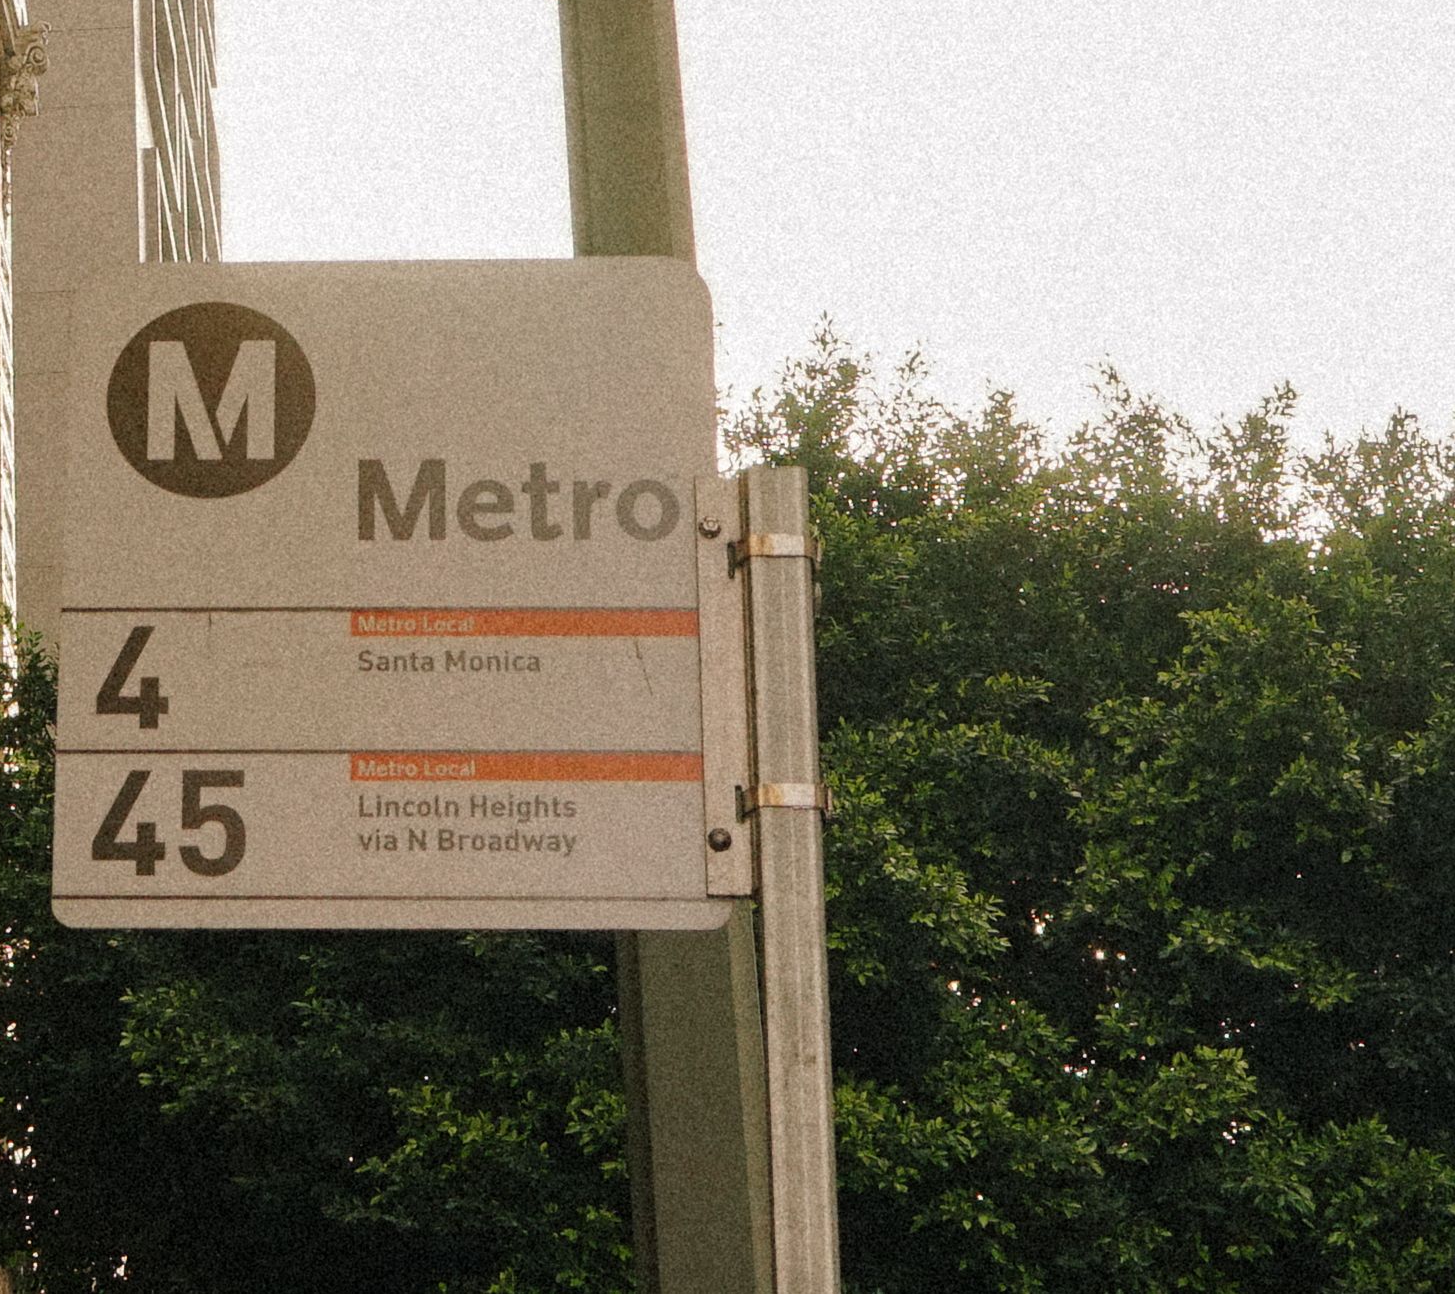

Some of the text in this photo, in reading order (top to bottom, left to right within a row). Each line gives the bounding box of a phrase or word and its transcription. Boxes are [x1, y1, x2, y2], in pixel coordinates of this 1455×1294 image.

[146, 339, 277, 461] M
[357, 458, 680, 541] Metro
[357, 615, 476, 632] Metro Local
[357, 649, 541, 672] Santa Monica
[95, 625, 169, 730] 4
[357, 760, 476, 776] Metro Local
[91, 768, 246, 877] 45
[358, 794, 578, 823] Lincoln Heights
[357, 829, 578, 857] via N Broadway
